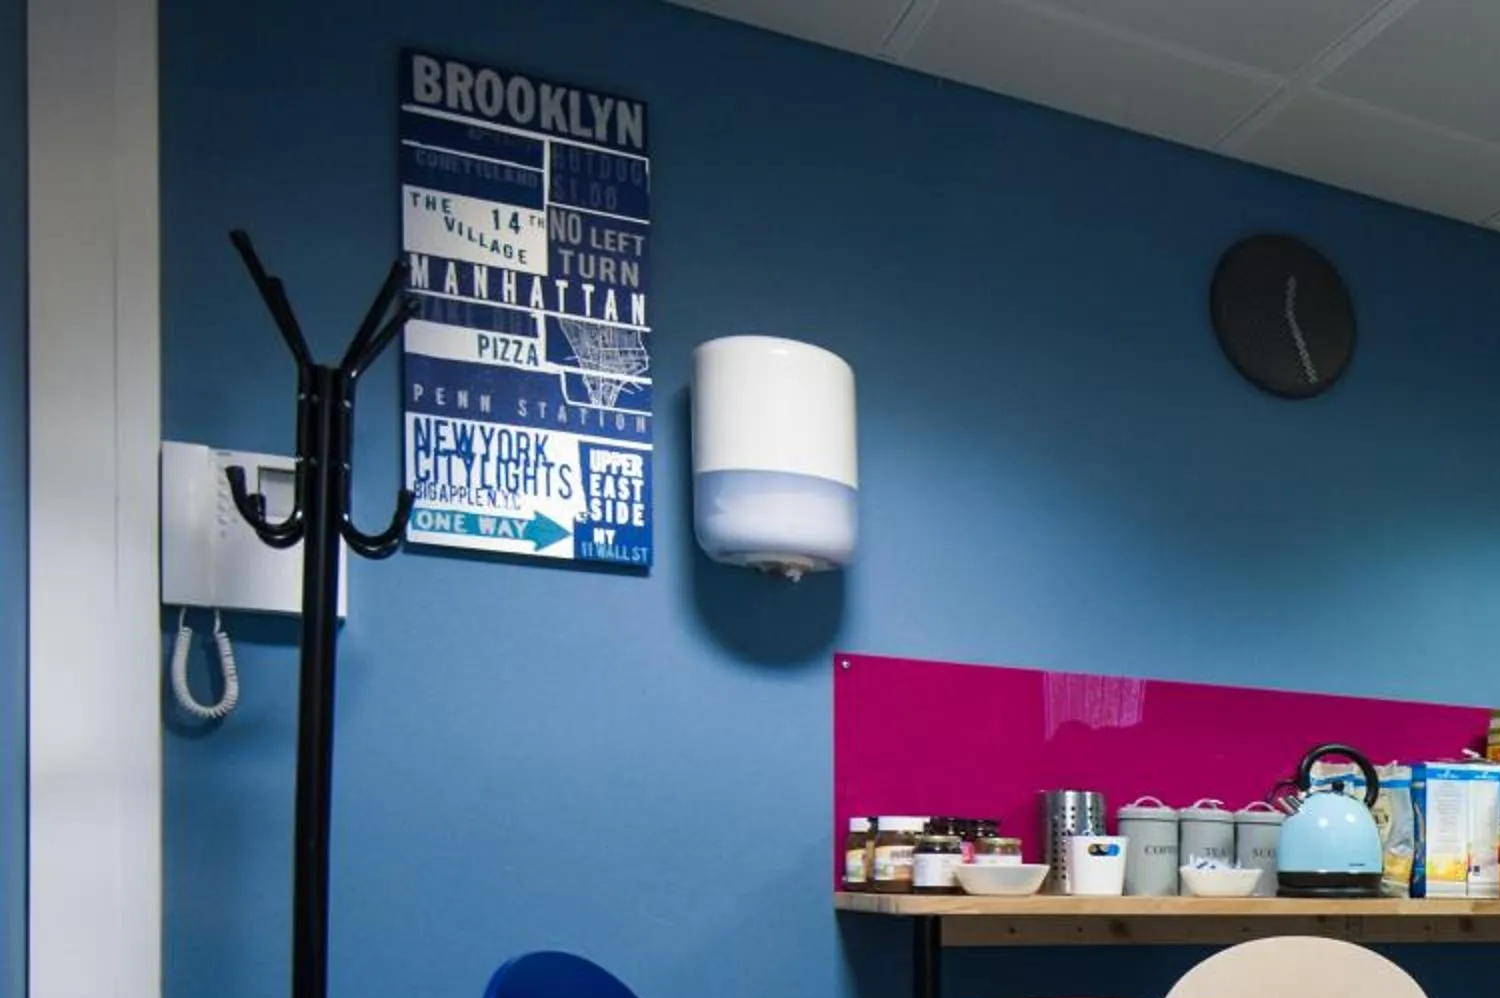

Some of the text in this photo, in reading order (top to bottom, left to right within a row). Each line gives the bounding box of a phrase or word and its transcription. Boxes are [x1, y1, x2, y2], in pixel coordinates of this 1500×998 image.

[412, 54, 643, 149] BROOKLYN
[410, 191, 451, 214] THE
[444, 216, 528, 265] VILLAGE
[550, 208, 645, 256] NO LEFT
[559, 250, 639, 288] TURN
[410, 252, 646, 326] MANHATTAN
[477, 333, 540, 367] PIZZA
[413, 383, 648, 433] PENN STATION
[589, 447, 643, 478] UPPER
[590, 473, 644, 502] EAST
[417, 509, 530, 539] ONE WAY
[590, 501, 645, 527] SIDE
